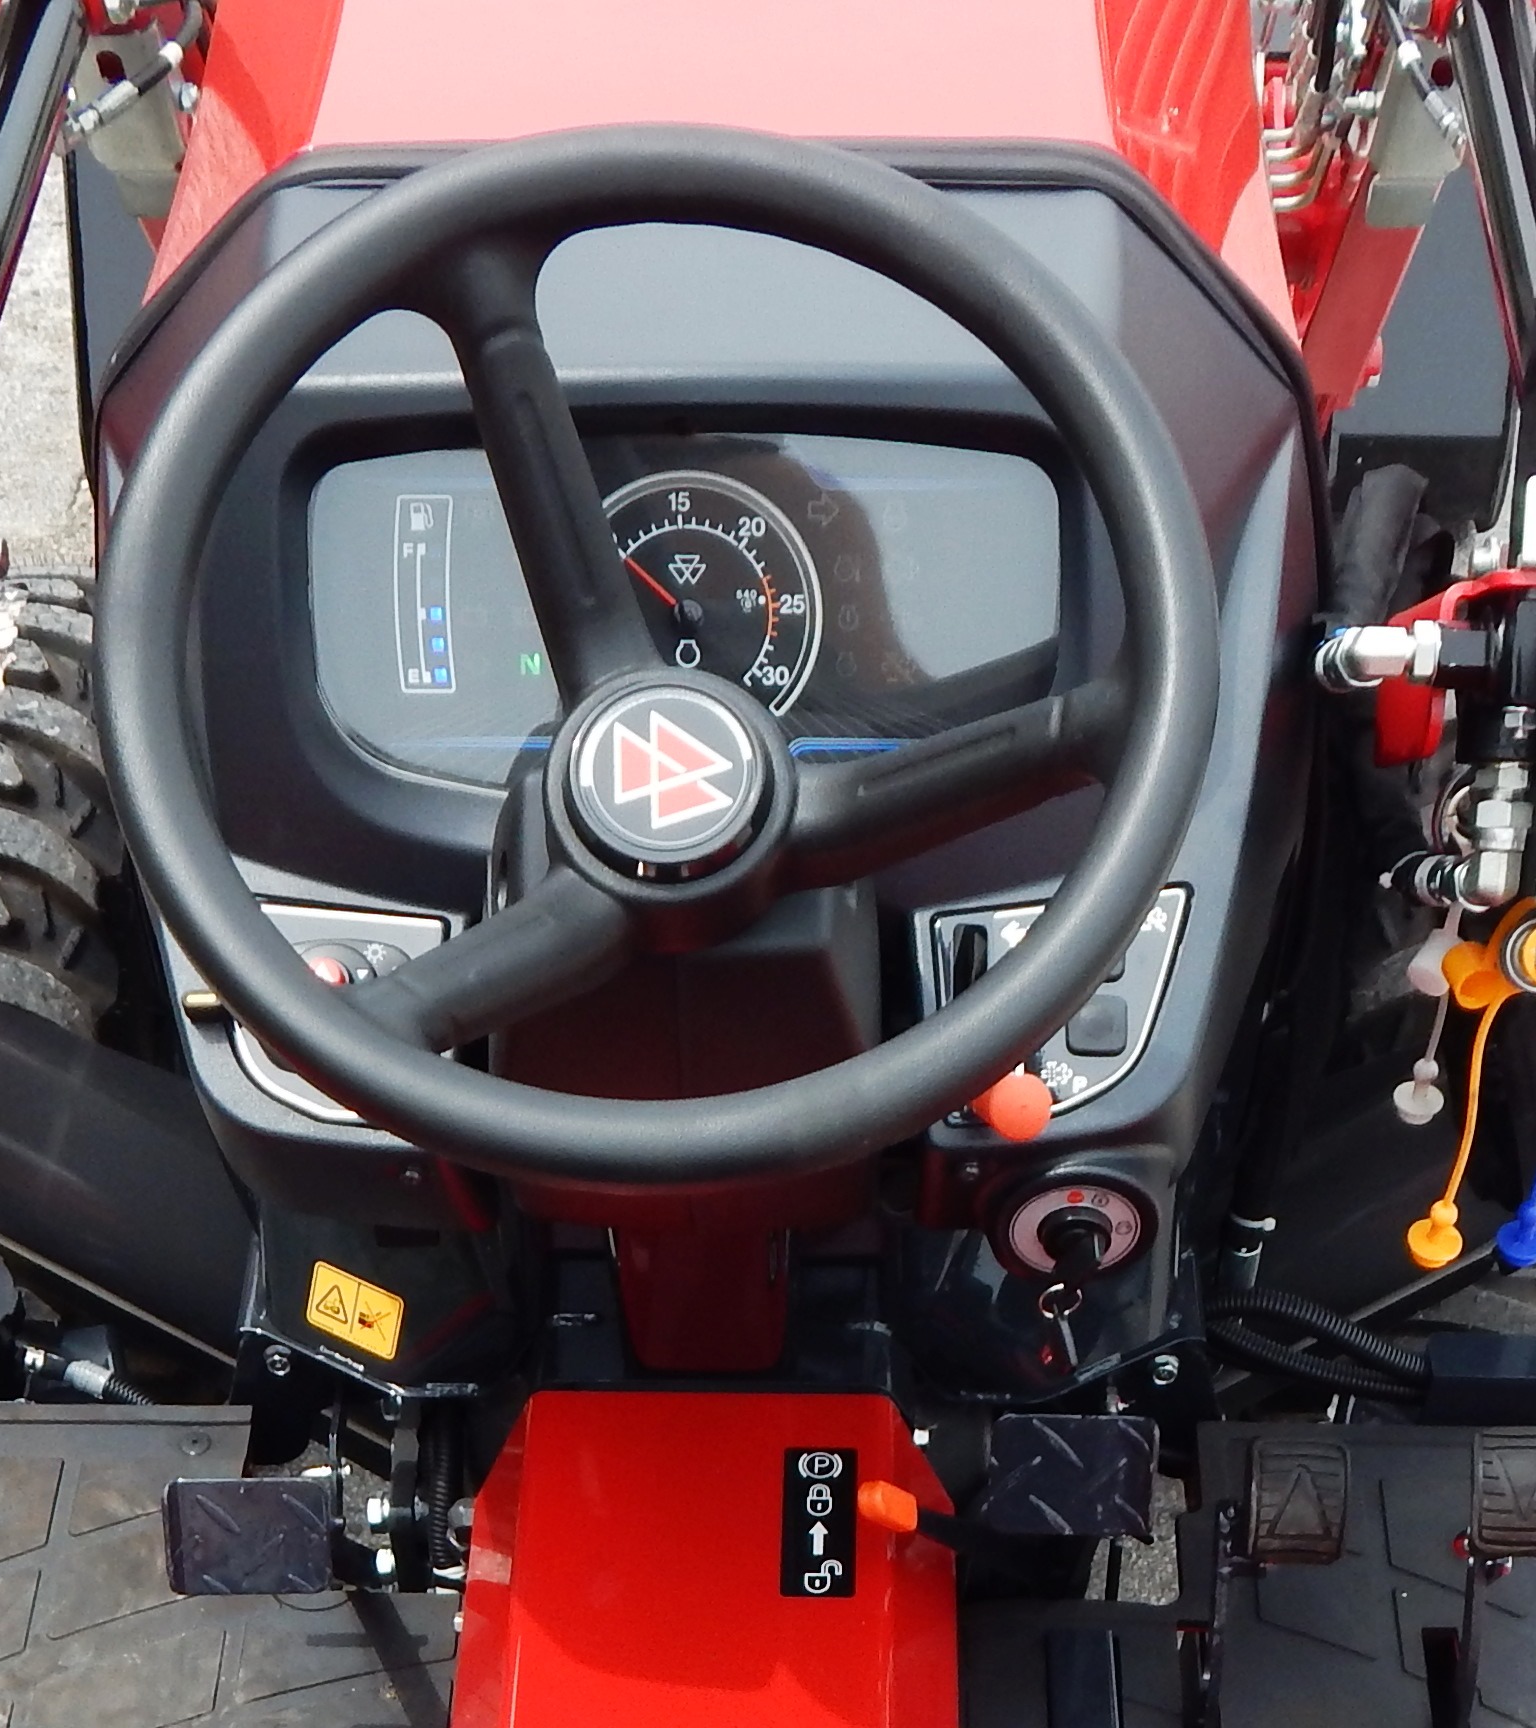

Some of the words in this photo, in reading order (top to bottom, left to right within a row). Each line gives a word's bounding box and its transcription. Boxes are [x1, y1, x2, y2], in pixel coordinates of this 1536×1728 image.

[668, 491, 691, 513] 15
[738, 516, 766, 538] 20
[403, 542, 414, 558] F
[780, 594, 806, 614] 25
[520, 652, 541, 675] N
[408, 668, 420, 684] E
[762, 666, 790, 687] 30
[1073, 1074, 1088, 1094] P
[815, 1456, 830, 1475] P
